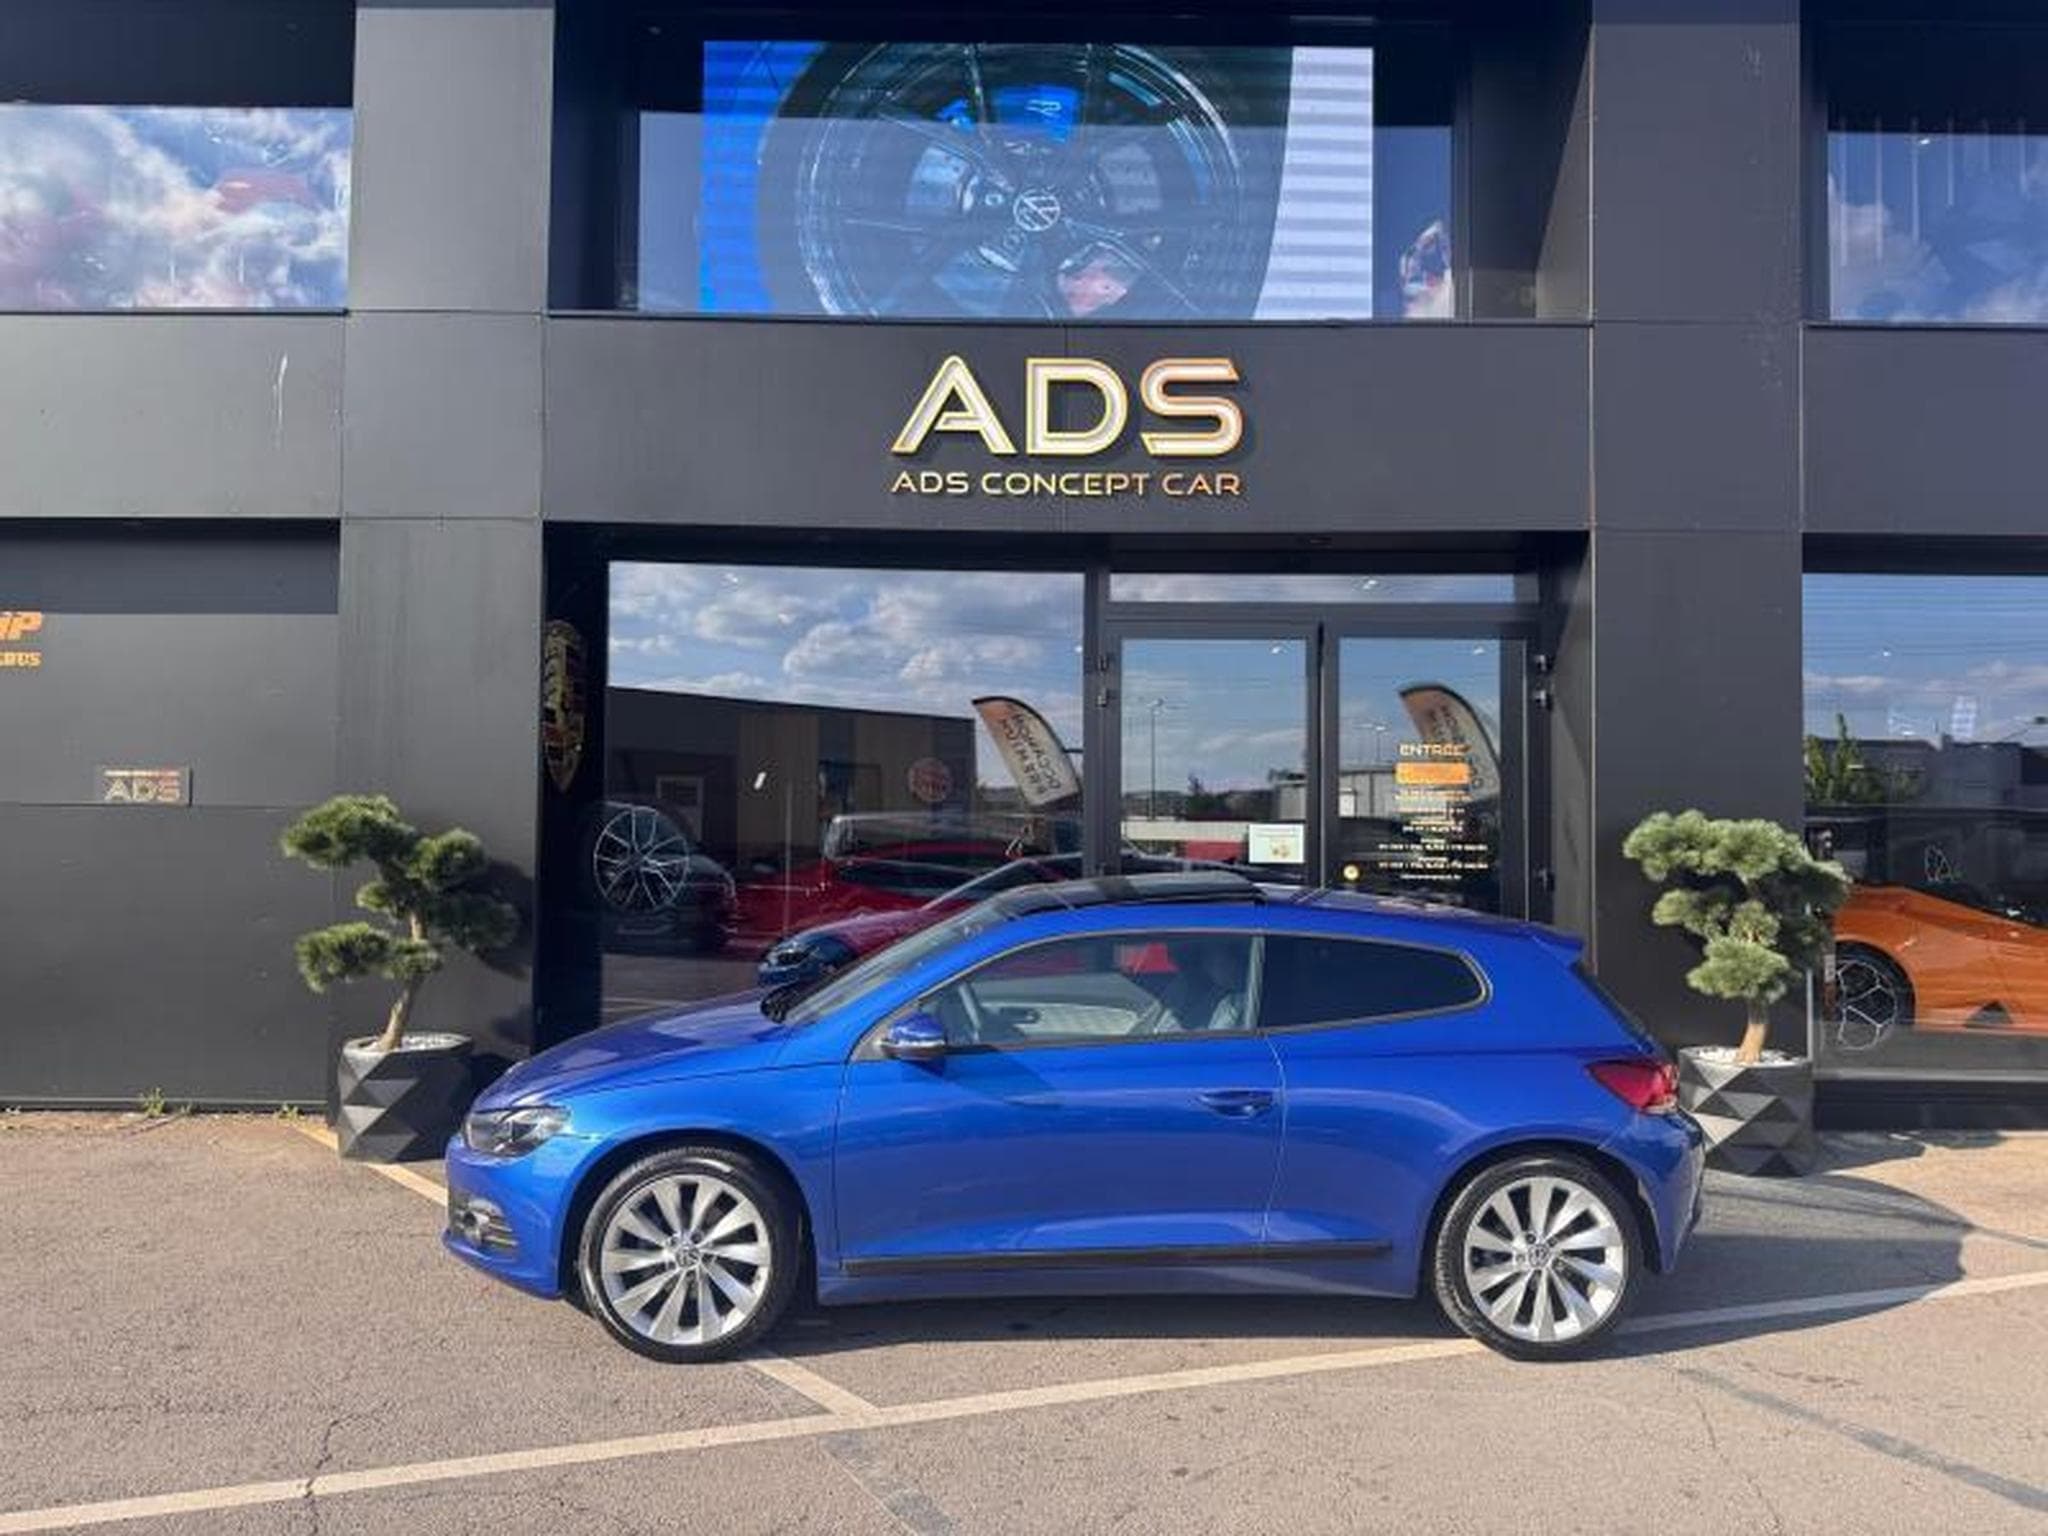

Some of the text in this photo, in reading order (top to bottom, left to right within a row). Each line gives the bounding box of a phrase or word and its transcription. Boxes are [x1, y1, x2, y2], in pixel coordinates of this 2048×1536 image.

[891, 354, 1244, 456] ADS
[891, 471, 1242, 497] ADS CONCEPT CAR
[103, 777, 181, 803] ADS
